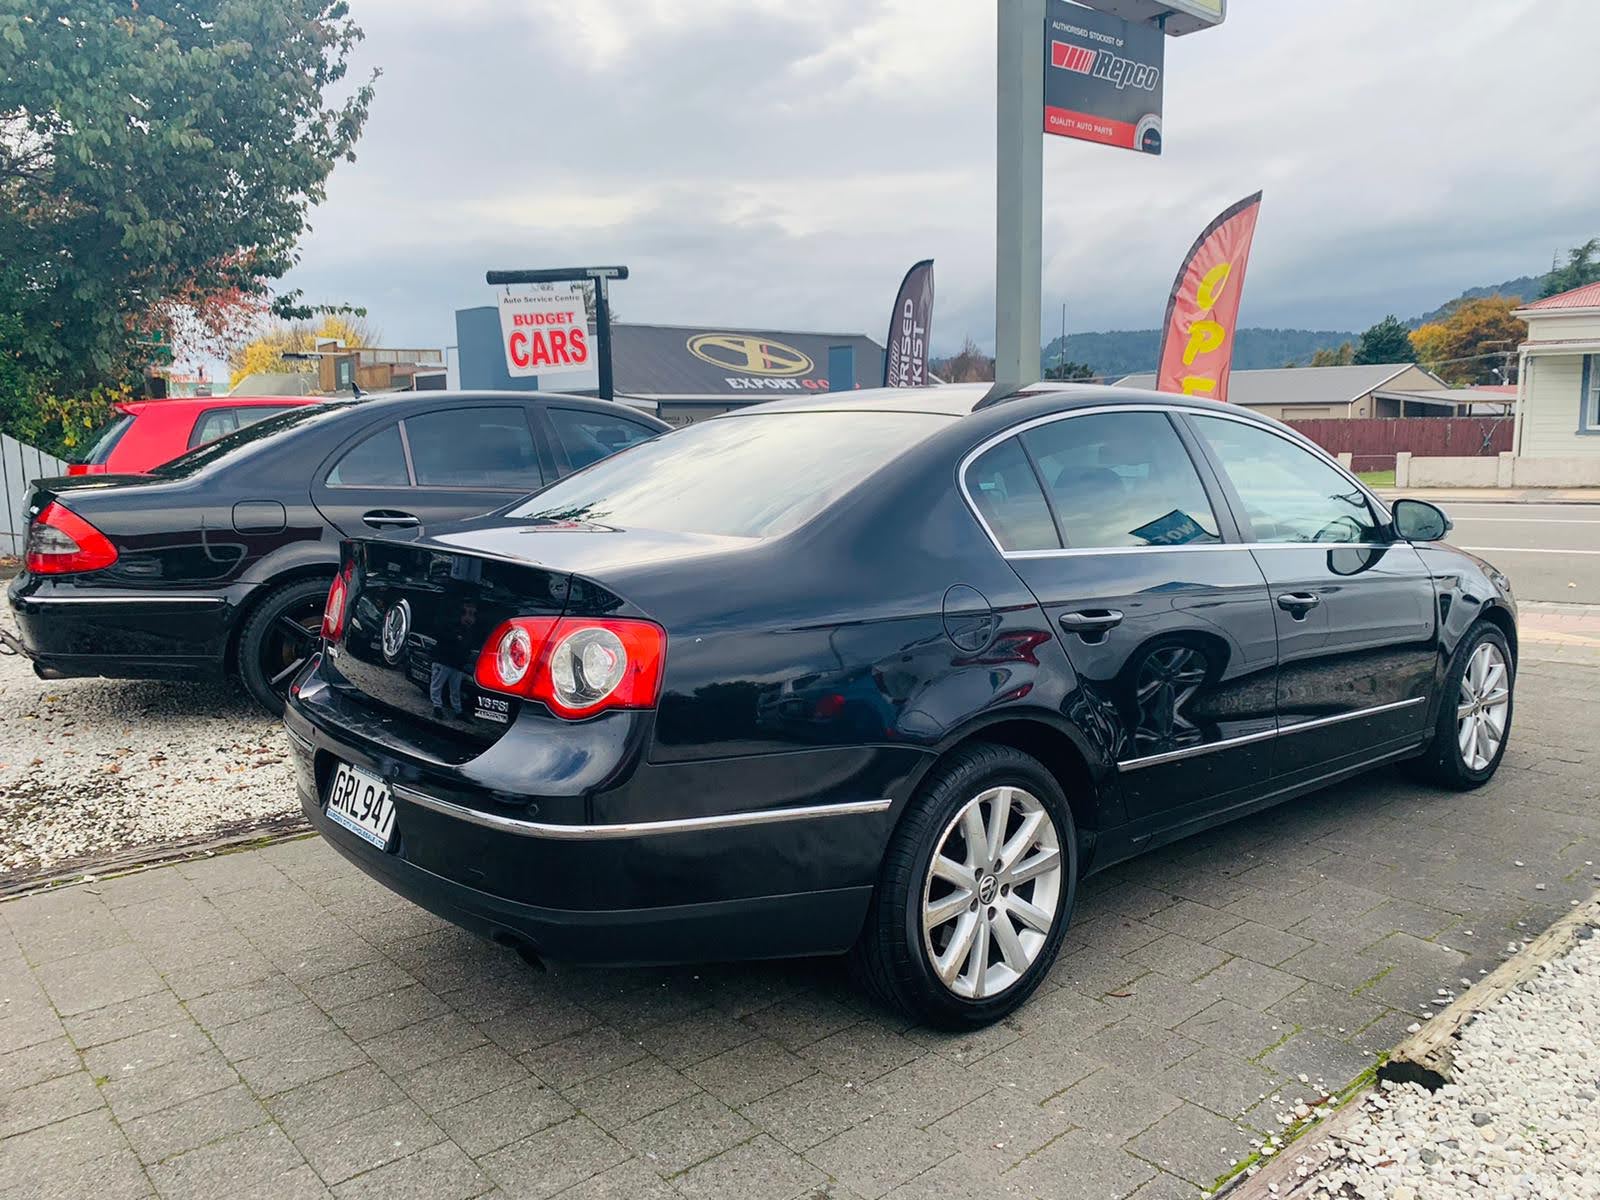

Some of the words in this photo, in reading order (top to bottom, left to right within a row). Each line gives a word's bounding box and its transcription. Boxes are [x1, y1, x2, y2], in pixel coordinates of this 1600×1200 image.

[1052, 21, 1088, 38] AUTHORISED
[1088, 30, 1116, 45] STOCKIST
[1116, 38, 1125, 48] OF
[1093, 49, 1160, 91] Repco
[1050, 115, 1076, 129] QUALITY
[1076, 121, 1094, 132] AUTO
[1093, 124, 1113, 137] PARTS
[524, 295, 553, 303] Service
[554, 294, 580, 302] Centre
[512, 311, 575, 326] BUDGET
[509, 327, 588, 368] CARS
[912, 320, 925, 386] KIST
[725, 377, 800, 390] EXPORT
[332, 770, 394, 833] GRL947
